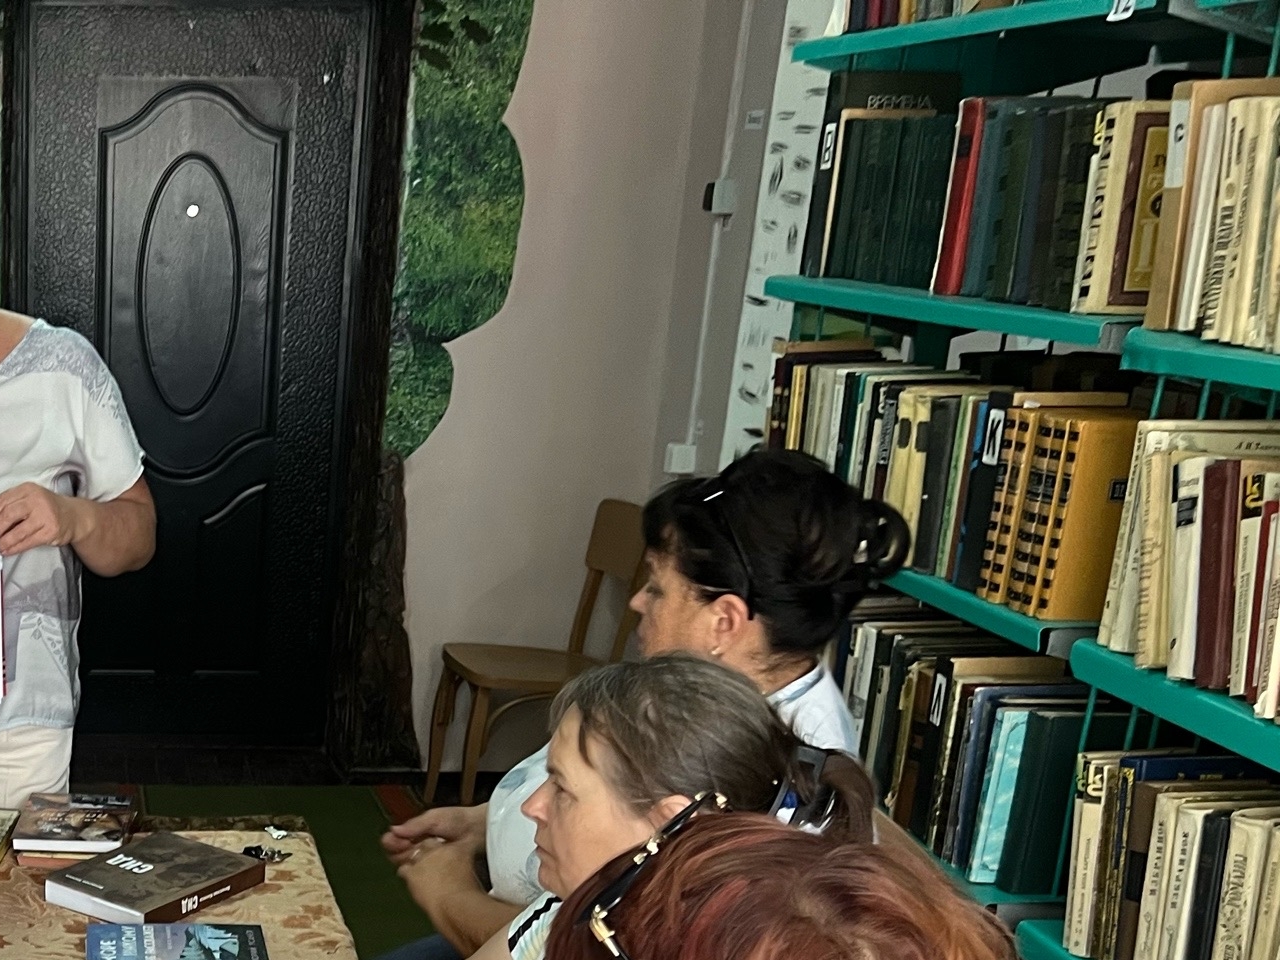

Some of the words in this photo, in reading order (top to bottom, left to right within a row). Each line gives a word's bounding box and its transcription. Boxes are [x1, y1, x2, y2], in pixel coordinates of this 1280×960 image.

[986, 417, 1002, 456] К
[106, 853, 154, 874] СИД
[180, 894, 199, 915] СИД
